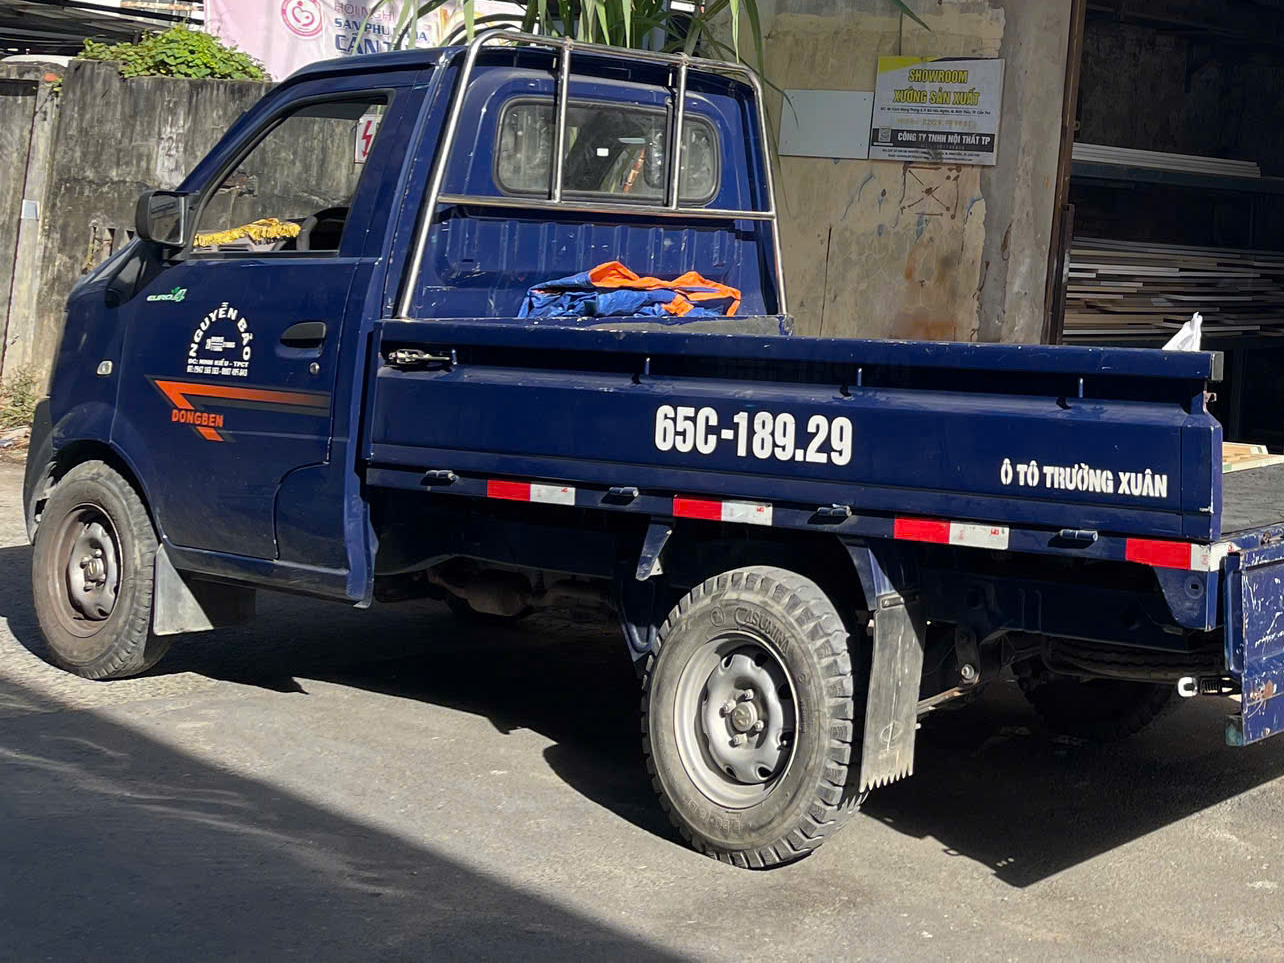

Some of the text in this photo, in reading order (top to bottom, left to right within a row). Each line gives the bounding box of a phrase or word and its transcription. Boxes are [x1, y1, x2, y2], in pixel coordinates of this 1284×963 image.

[908, 69, 968, 84] SHOWROOM
[929, 87, 950, 105] SẢN
[951, 87, 980, 106] XUẤT
[897, 131, 916, 141] CÔNG
[918, 133, 926, 141] TY
[981, 136, 991, 145] TP
[188, 302, 238, 357] NGUYỄN
[171, 409, 224, 428] DONGBEN
[654, 404, 854, 467] 65C-189.29
[1000, 458, 1168, 498] Ô TÔ TRƯỜNG XUÂN
